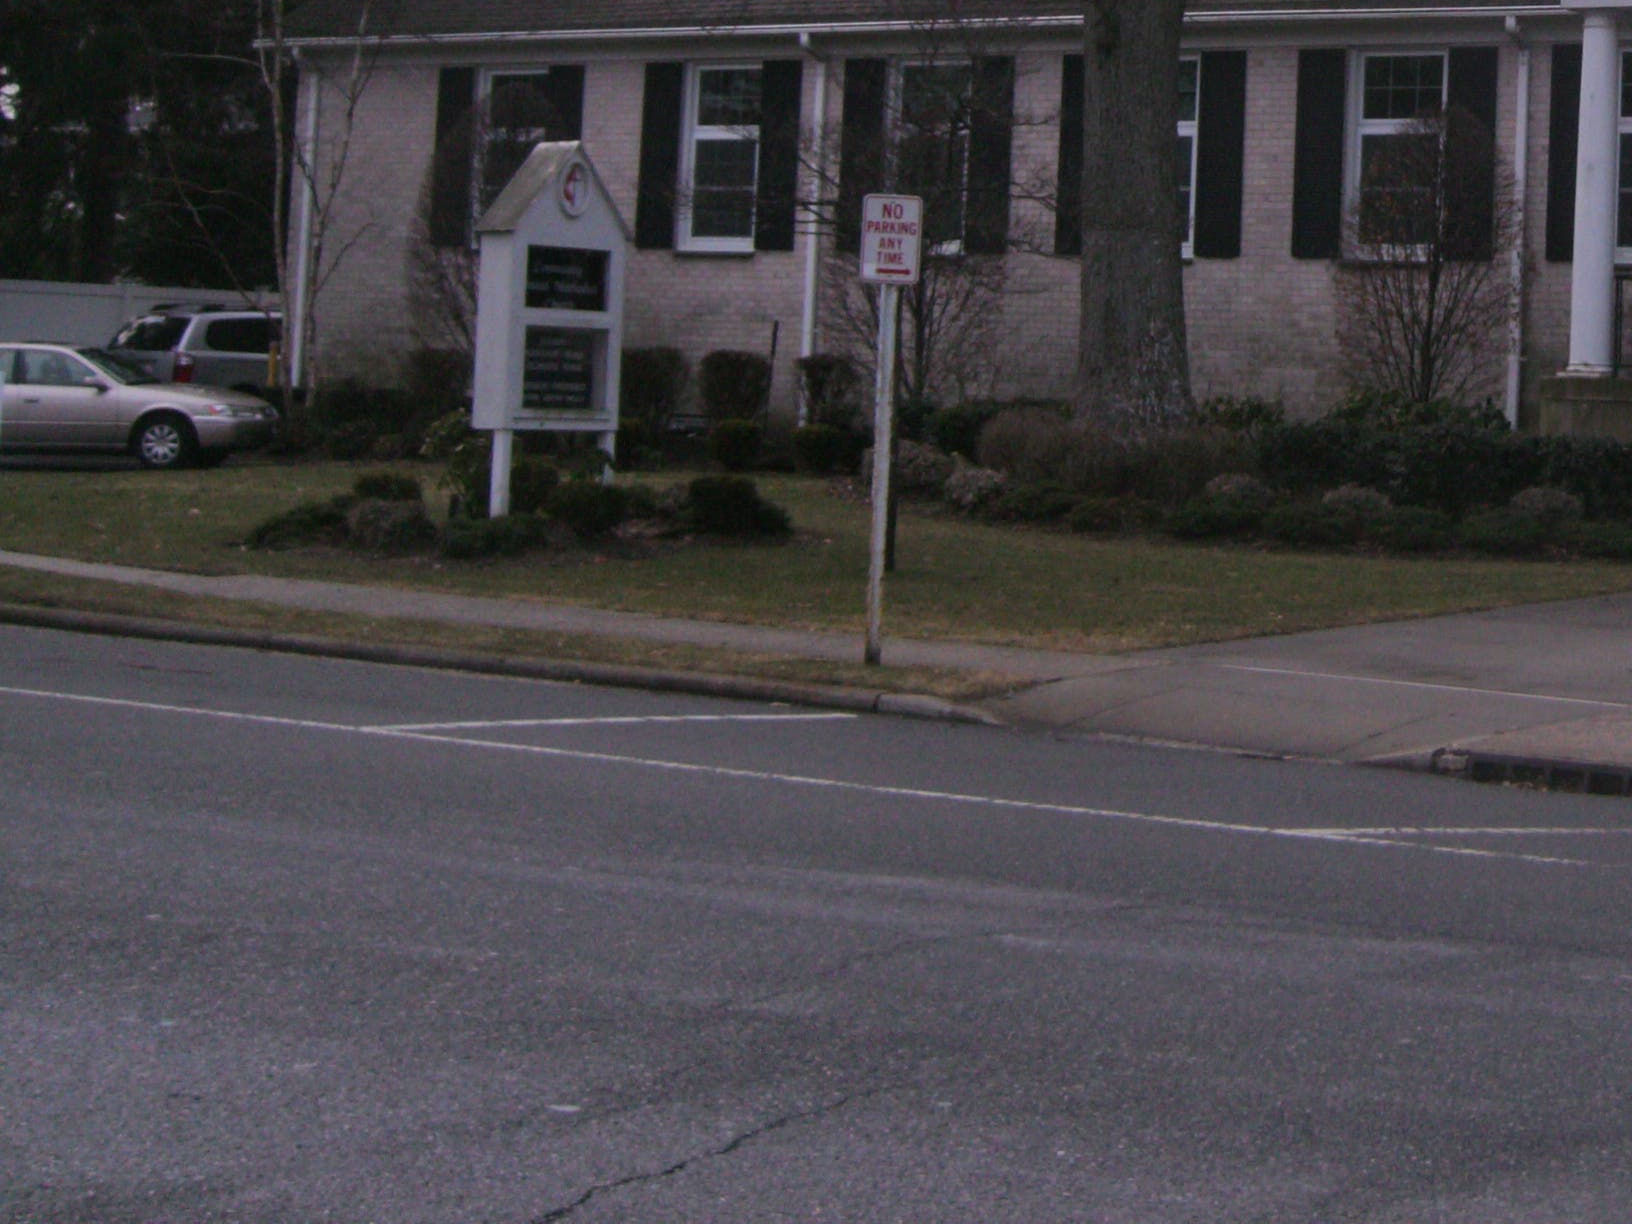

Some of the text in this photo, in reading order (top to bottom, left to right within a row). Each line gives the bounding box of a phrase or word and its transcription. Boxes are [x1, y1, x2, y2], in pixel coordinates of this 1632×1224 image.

[882, 203, 904, 219] NO
[866, 221, 917, 235] PARKING
[878, 237, 903, 250] ANY
[877, 252, 904, 265] TIME
